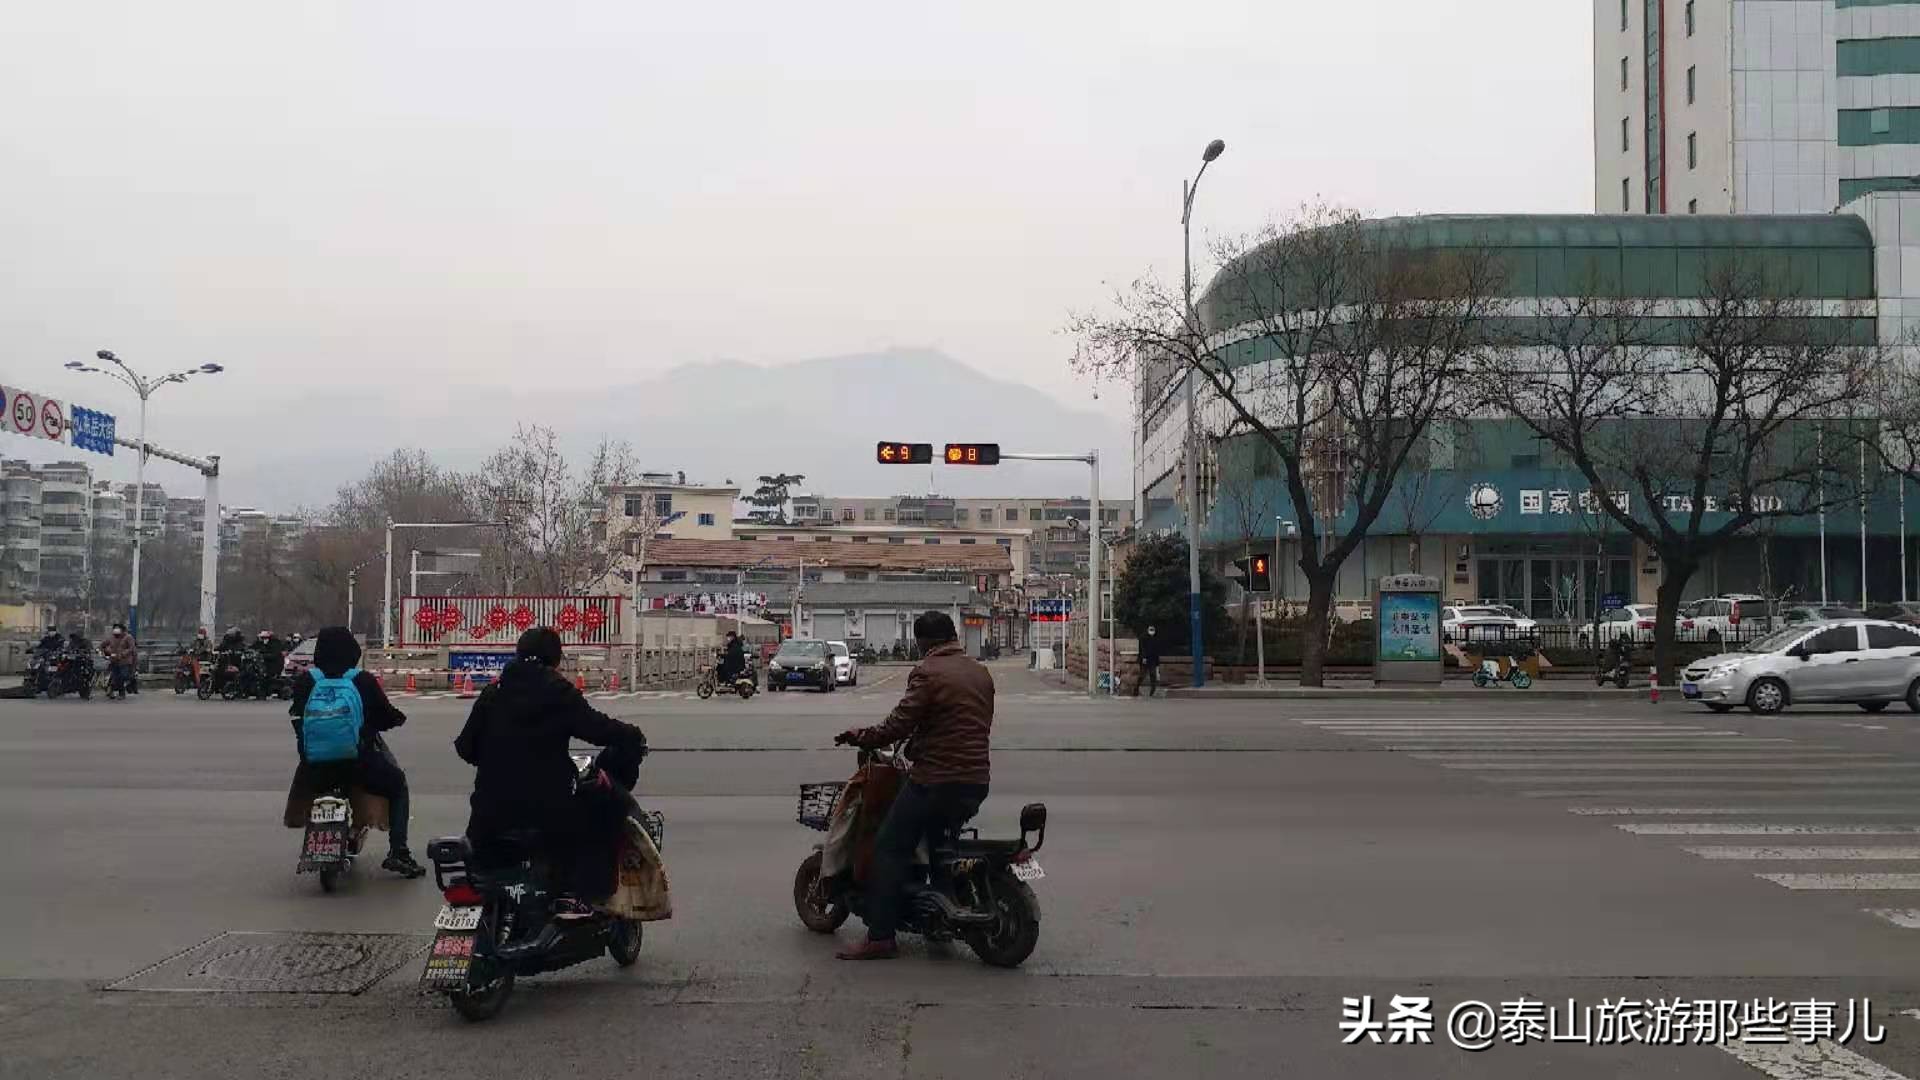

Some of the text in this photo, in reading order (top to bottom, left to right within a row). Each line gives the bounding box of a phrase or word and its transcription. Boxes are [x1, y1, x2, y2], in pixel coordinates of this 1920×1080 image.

[16, 403, 33, 422] 50
[901, 445, 909, 460] 9
[968, 447, 976, 461] 8
